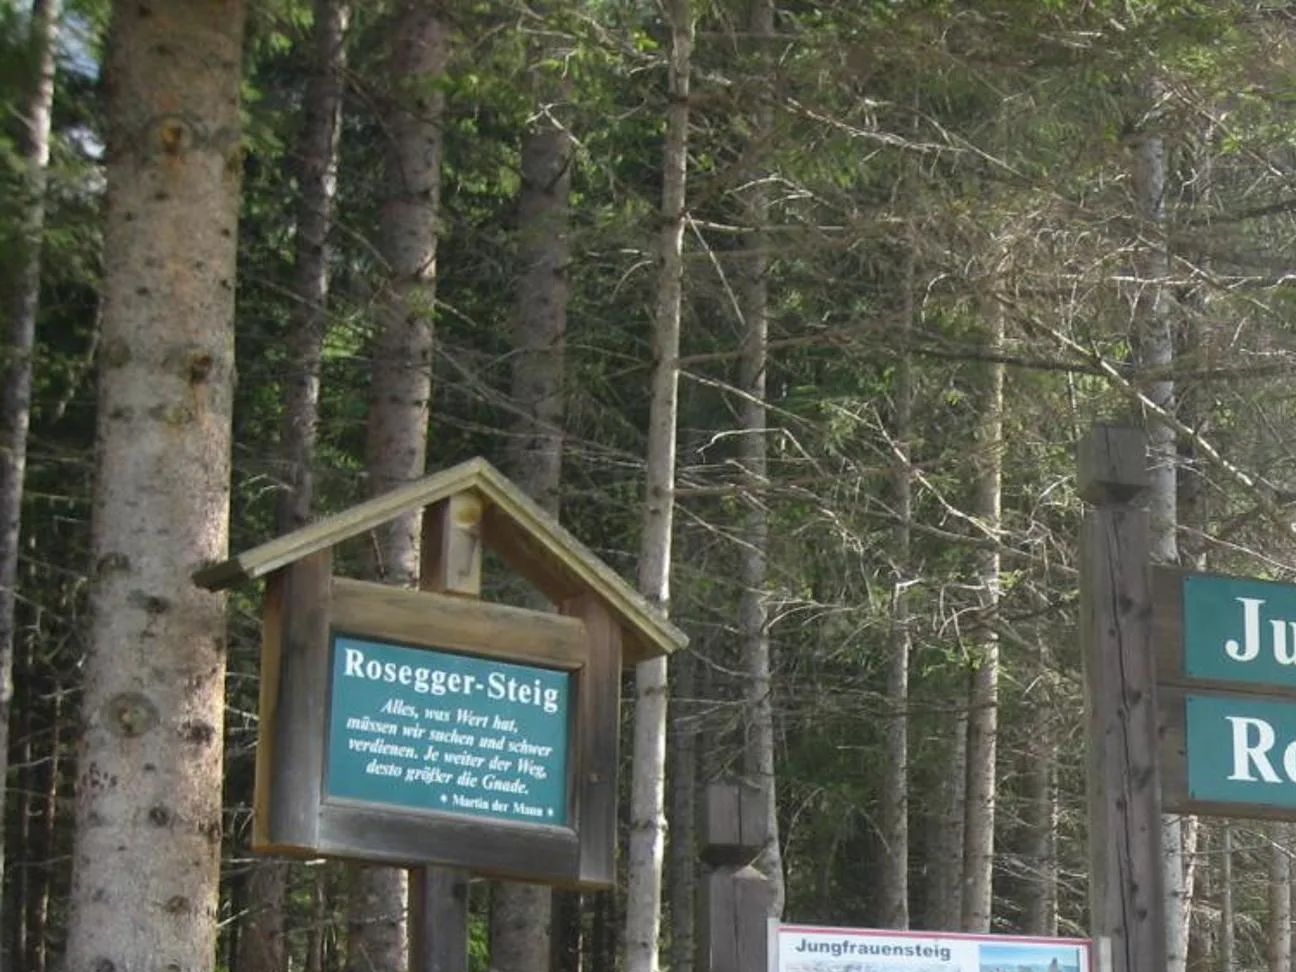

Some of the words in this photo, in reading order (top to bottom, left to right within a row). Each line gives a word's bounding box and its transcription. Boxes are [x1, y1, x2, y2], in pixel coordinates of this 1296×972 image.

[344, 648, 559, 713] Rosegger-Steig
[380, 699, 419, 719] Alles,
[425, 708, 450, 722] was
[456, 708, 489, 727] Wert
[492, 714, 519, 734] hat,
[346, 716, 397, 736] müssen
[402, 723, 426, 739] wir
[429, 729, 474, 747] suchen
[478, 734, 506, 751] und
[507, 739, 553, 757] schwer
[348, 737, 419, 760] verdienen.
[423, 745, 439, 762] Je
[444, 750, 485, 769] weiter
[489, 755, 513, 772] der
[366, 759, 402, 777] desto
[404, 765, 454, 785] größer
[457, 770, 478, 788] die
[481, 774, 529, 795] Gnade.
[452, 793, 489, 810] Martin
[492, 798, 508, 813] der
[794, 938, 952, 962] Jungfrauensteig
